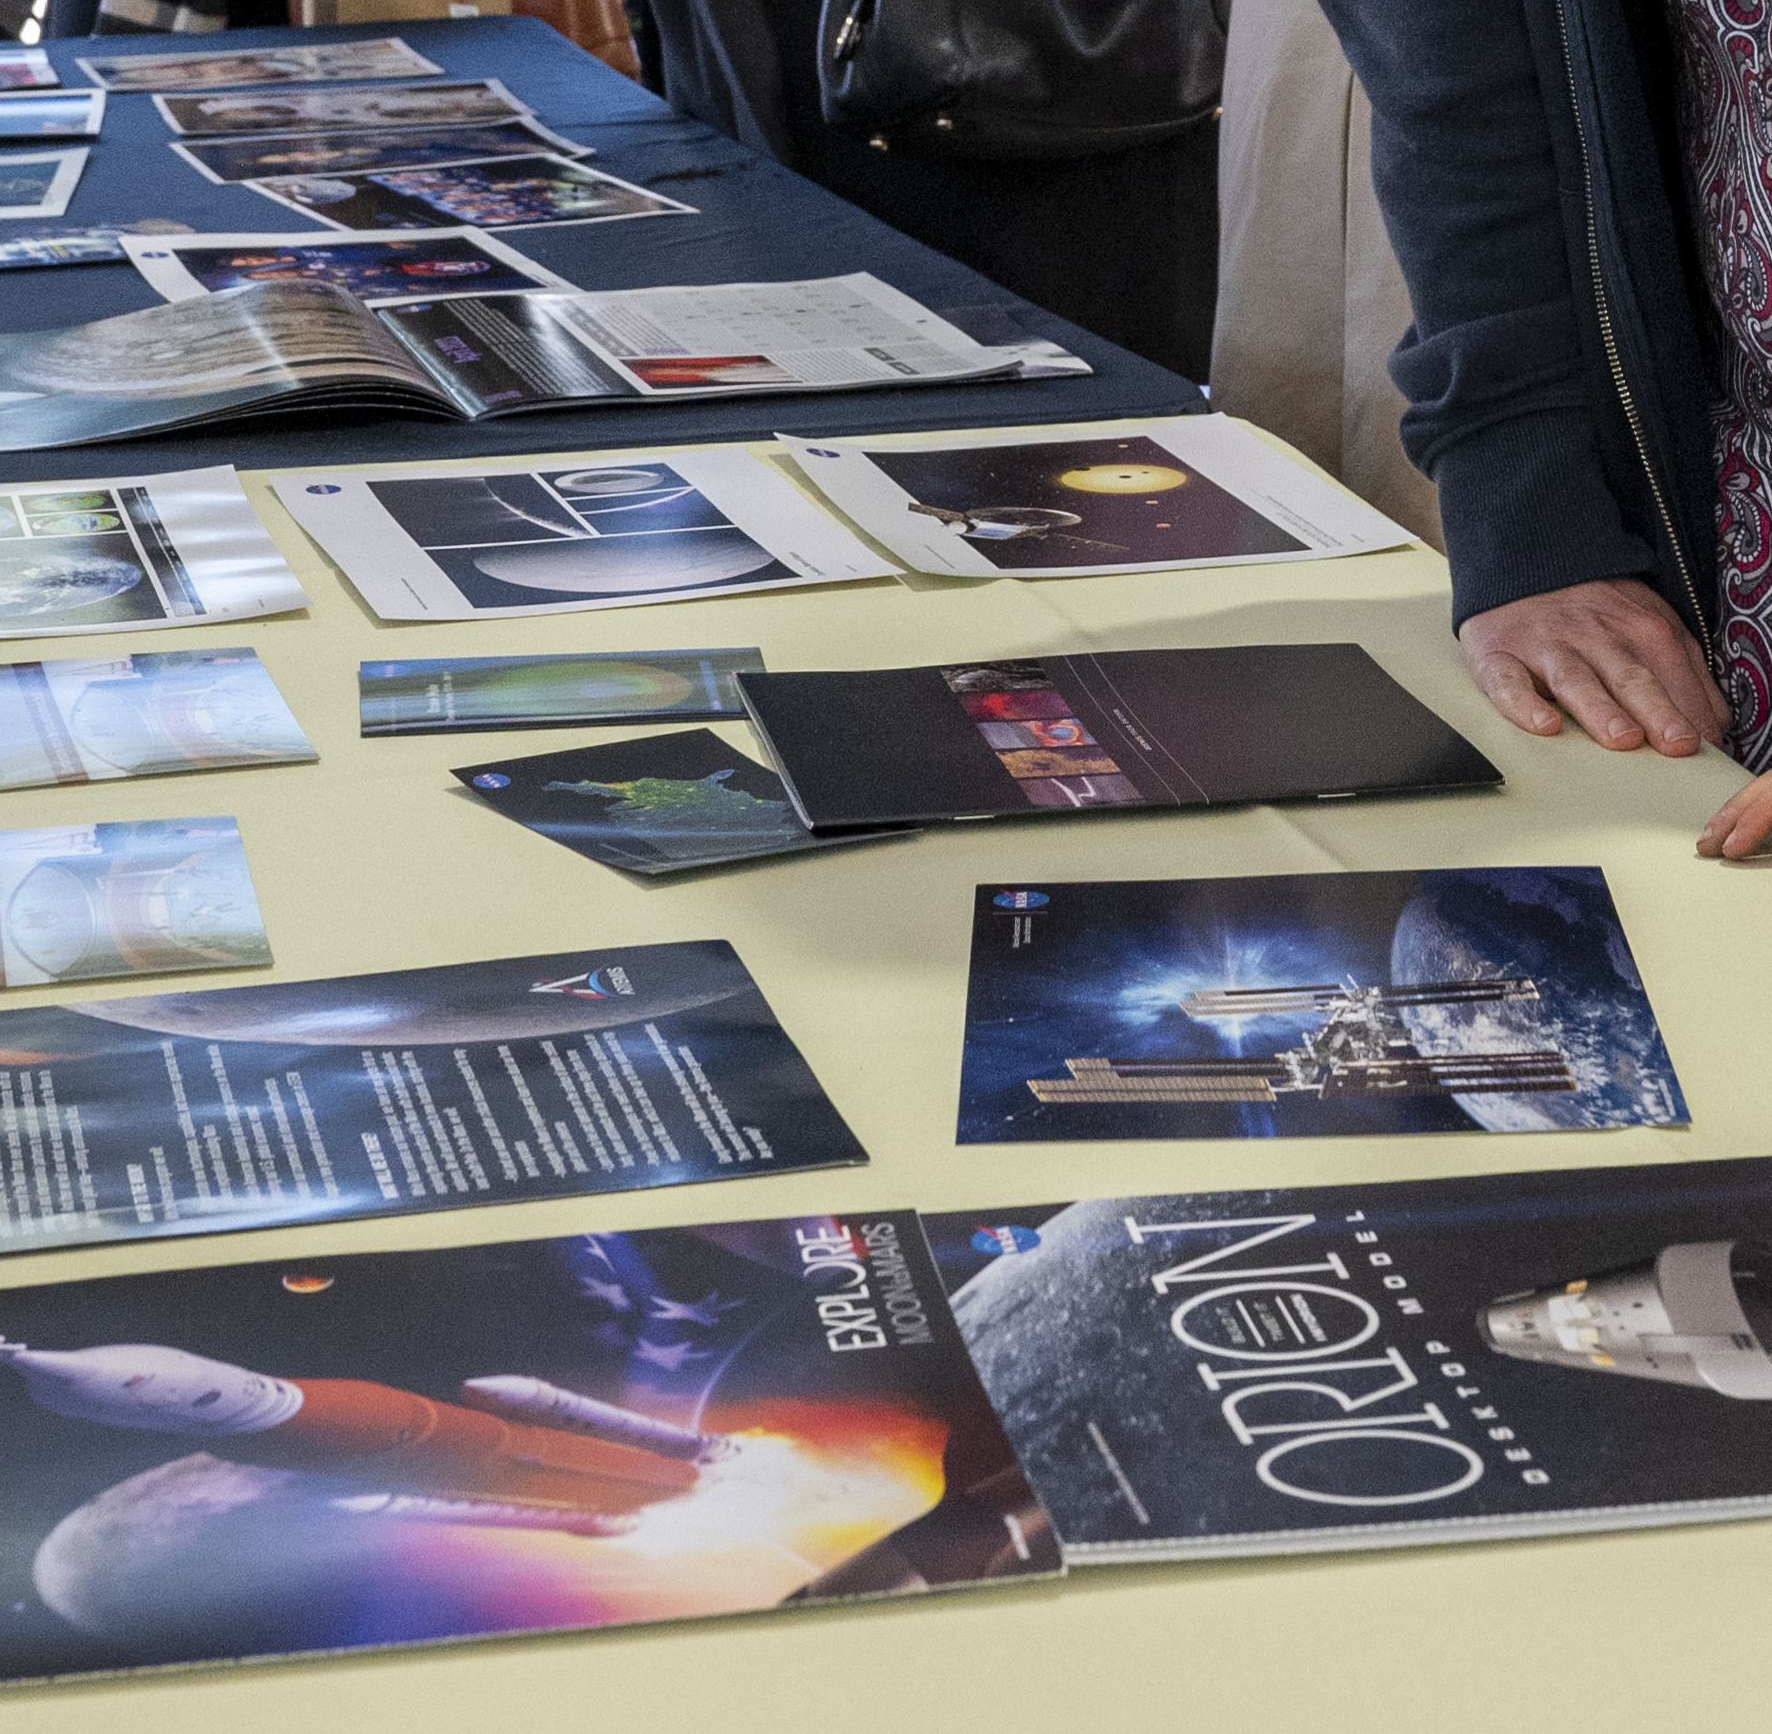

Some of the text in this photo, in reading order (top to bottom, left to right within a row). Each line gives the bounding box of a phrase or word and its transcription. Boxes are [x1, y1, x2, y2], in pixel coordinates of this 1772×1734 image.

[606, 966, 636, 995] ARTEMIS
[795, 1224, 888, 1352] EXPLORE
[1125, 1213, 1484, 1506] ORION
[1345, 1209, 1549, 1486] DESKTOP MODEL
